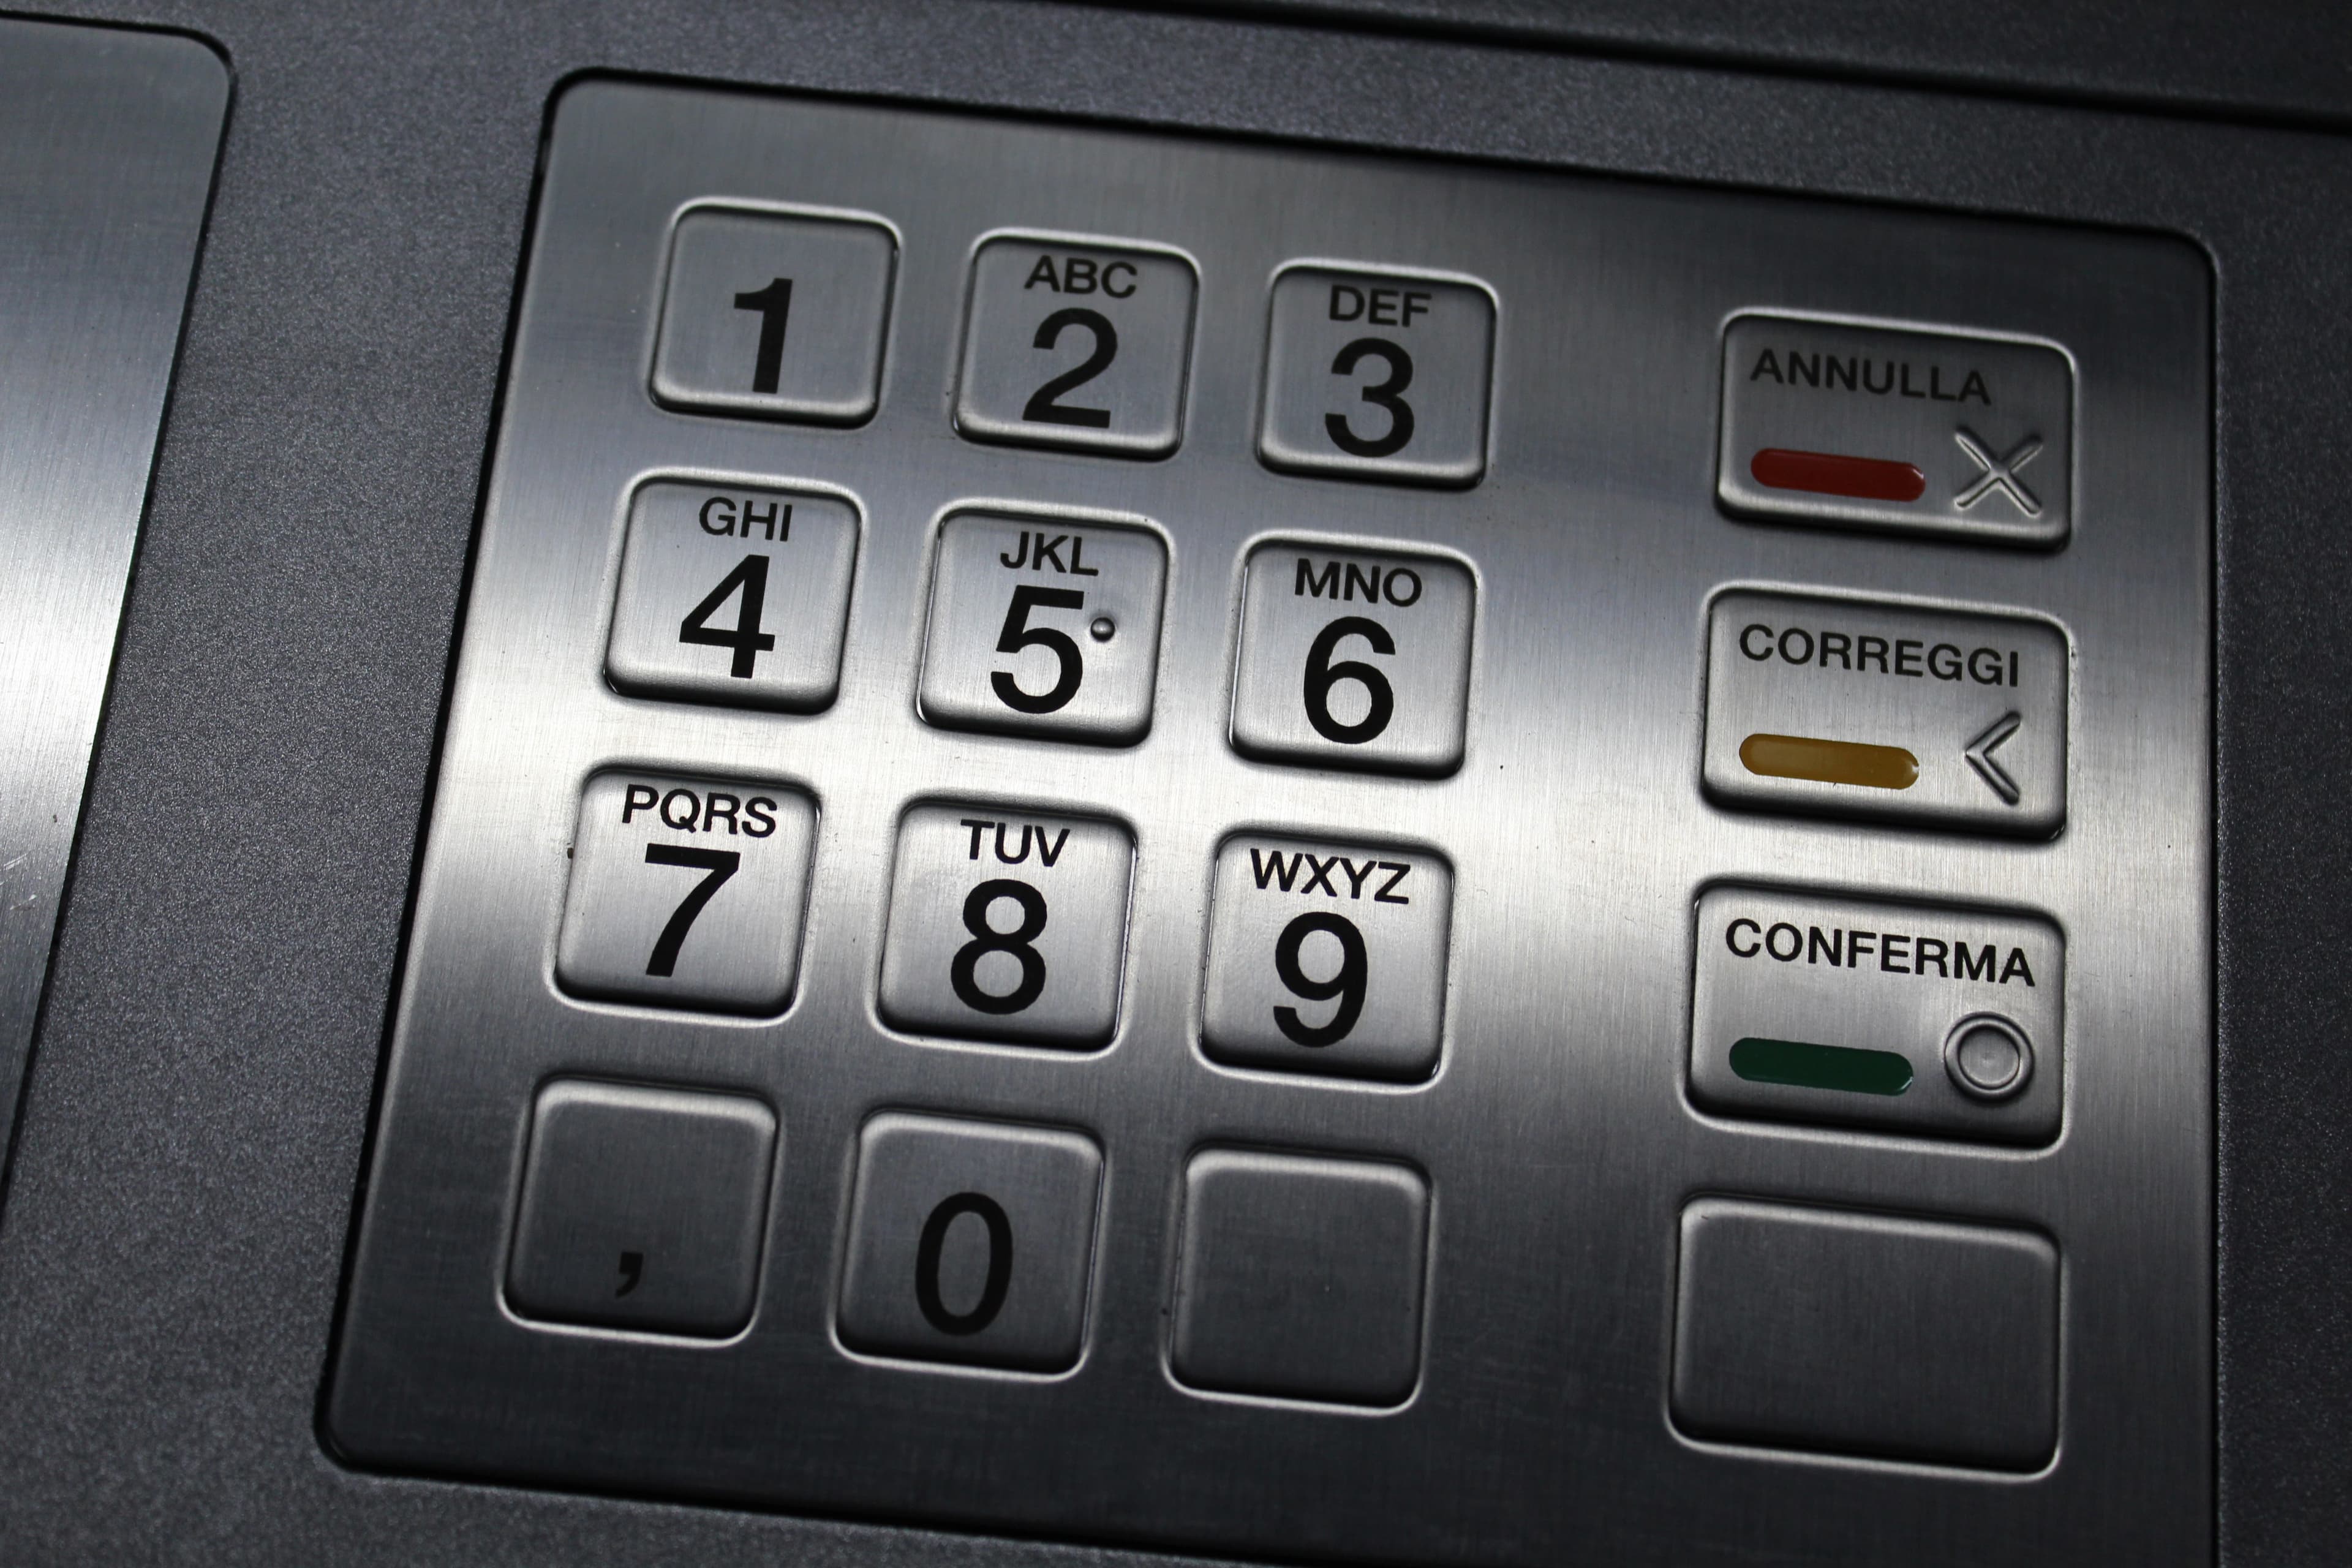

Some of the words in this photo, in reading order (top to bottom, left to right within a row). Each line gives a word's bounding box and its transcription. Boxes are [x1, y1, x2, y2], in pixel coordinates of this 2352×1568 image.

[1023, 254, 1138, 298] ABC
[1328, 283, 1432, 327] DEF
[734, 278, 793, 394] 1
[1023, 308, 1117, 428] 2
[1325, 338, 1414, 457] 3
[1750, 348, 1991, 405] ANNULLA
[699, 496, 793, 541] GHI
[1000, 530, 1099, 576] JKL
[1294, 557, 1423, 607] MNO
[679, 555, 775, 679] 4
[991, 585, 1084, 714] 5
[1304, 617, 1395, 744] 6
[1740, 624, 2018, 687] CORREGGI
[622, 783, 777, 838] PQRS
[962, 819, 1071, 867] TUV
[645, 843, 741, 977] 7
[1250, 847, 1411, 904] WXYZ
[951, 879, 1047, 1016] 8
[1273, 912, 1367, 1048] 9
[1726, 918, 2035, 987] CONFERMA
[916, 1192, 1012, 1336] 0
